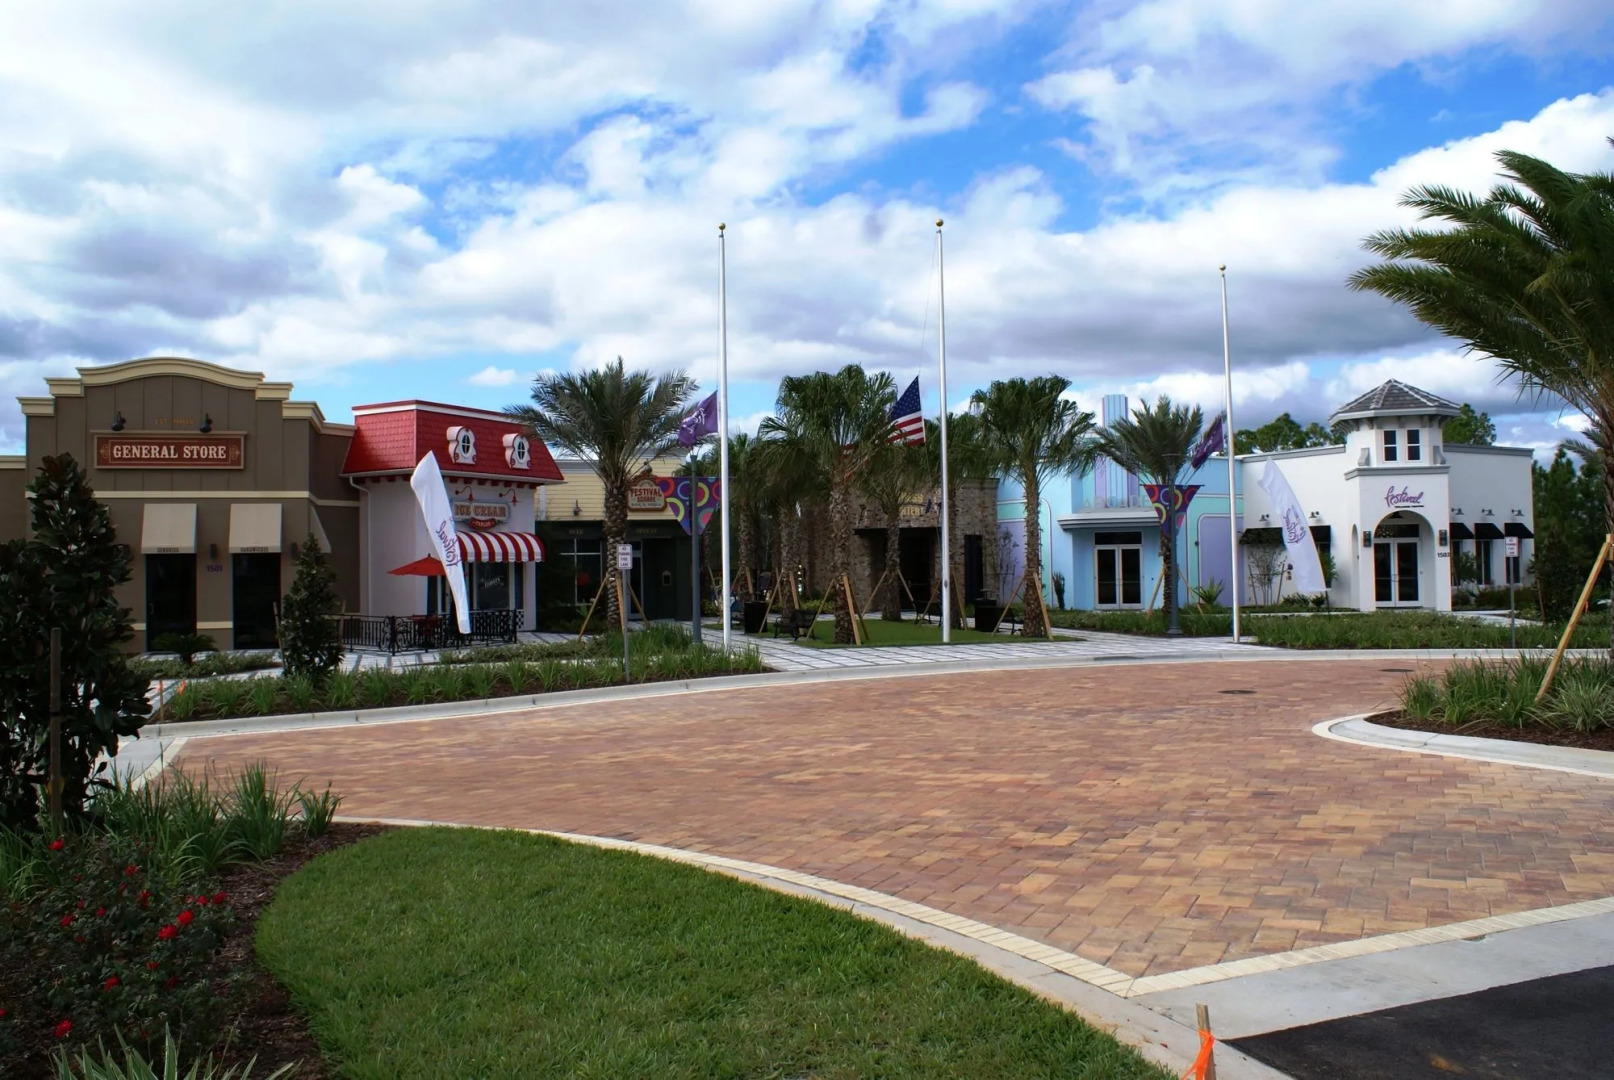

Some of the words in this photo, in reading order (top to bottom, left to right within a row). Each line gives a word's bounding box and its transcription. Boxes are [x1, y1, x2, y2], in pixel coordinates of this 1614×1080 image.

[113, 445, 178, 459] GENERAL
[183, 445, 227, 459] STORE
[631, 487, 662, 497] FESTIVAL
[455, 504, 471, 516] ICE
[474, 505, 506, 517] CREAM
